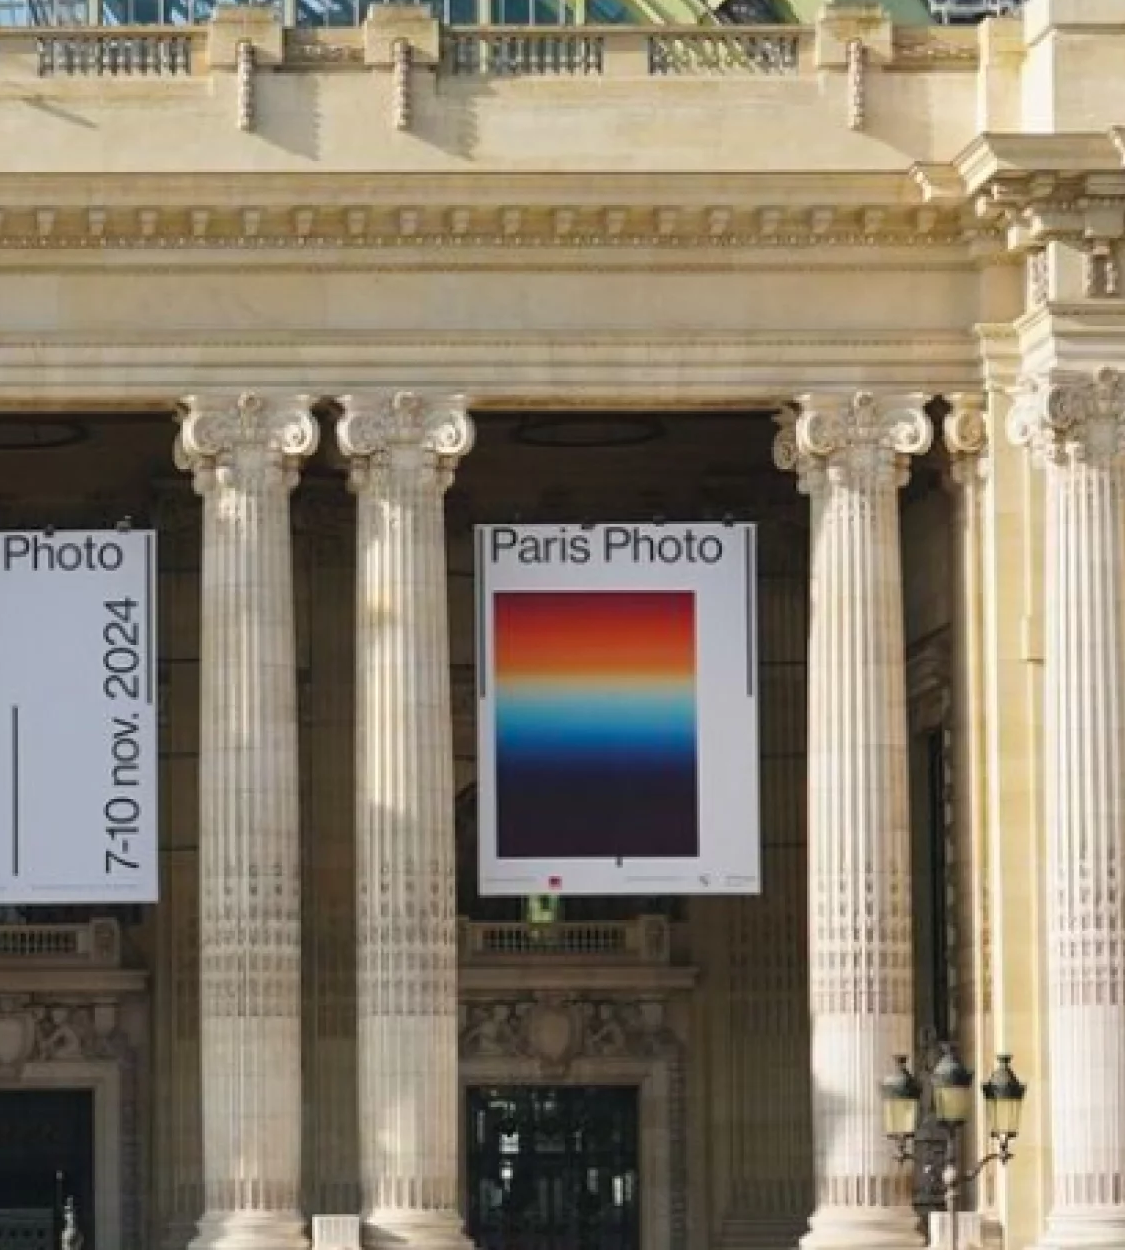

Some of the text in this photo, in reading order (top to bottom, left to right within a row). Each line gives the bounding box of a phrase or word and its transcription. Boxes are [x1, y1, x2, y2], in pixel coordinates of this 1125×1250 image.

[3, 534, 123, 571] Photo
[491, 527, 723, 563] Paris Photo
[102, 597, 140, 874] 7-10 nov. 2024
